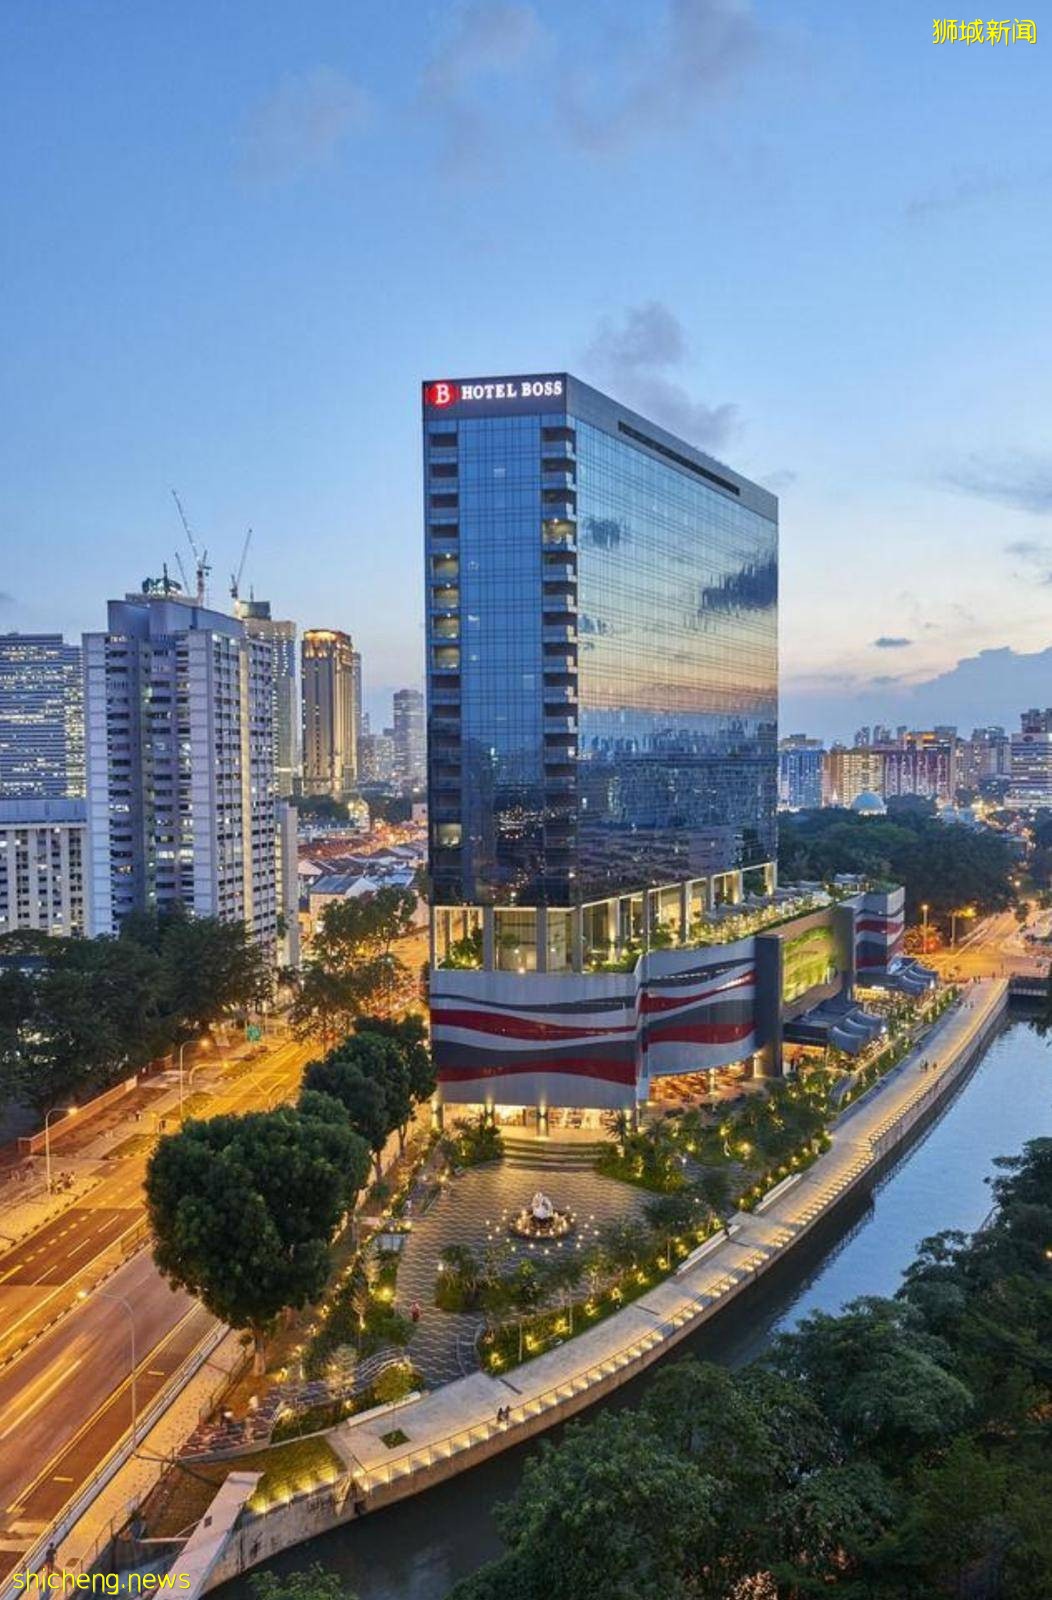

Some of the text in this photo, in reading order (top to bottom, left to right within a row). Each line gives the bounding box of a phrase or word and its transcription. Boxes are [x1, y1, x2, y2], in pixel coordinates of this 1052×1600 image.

[435, 380, 562, 404] B HOTEL BOSS
